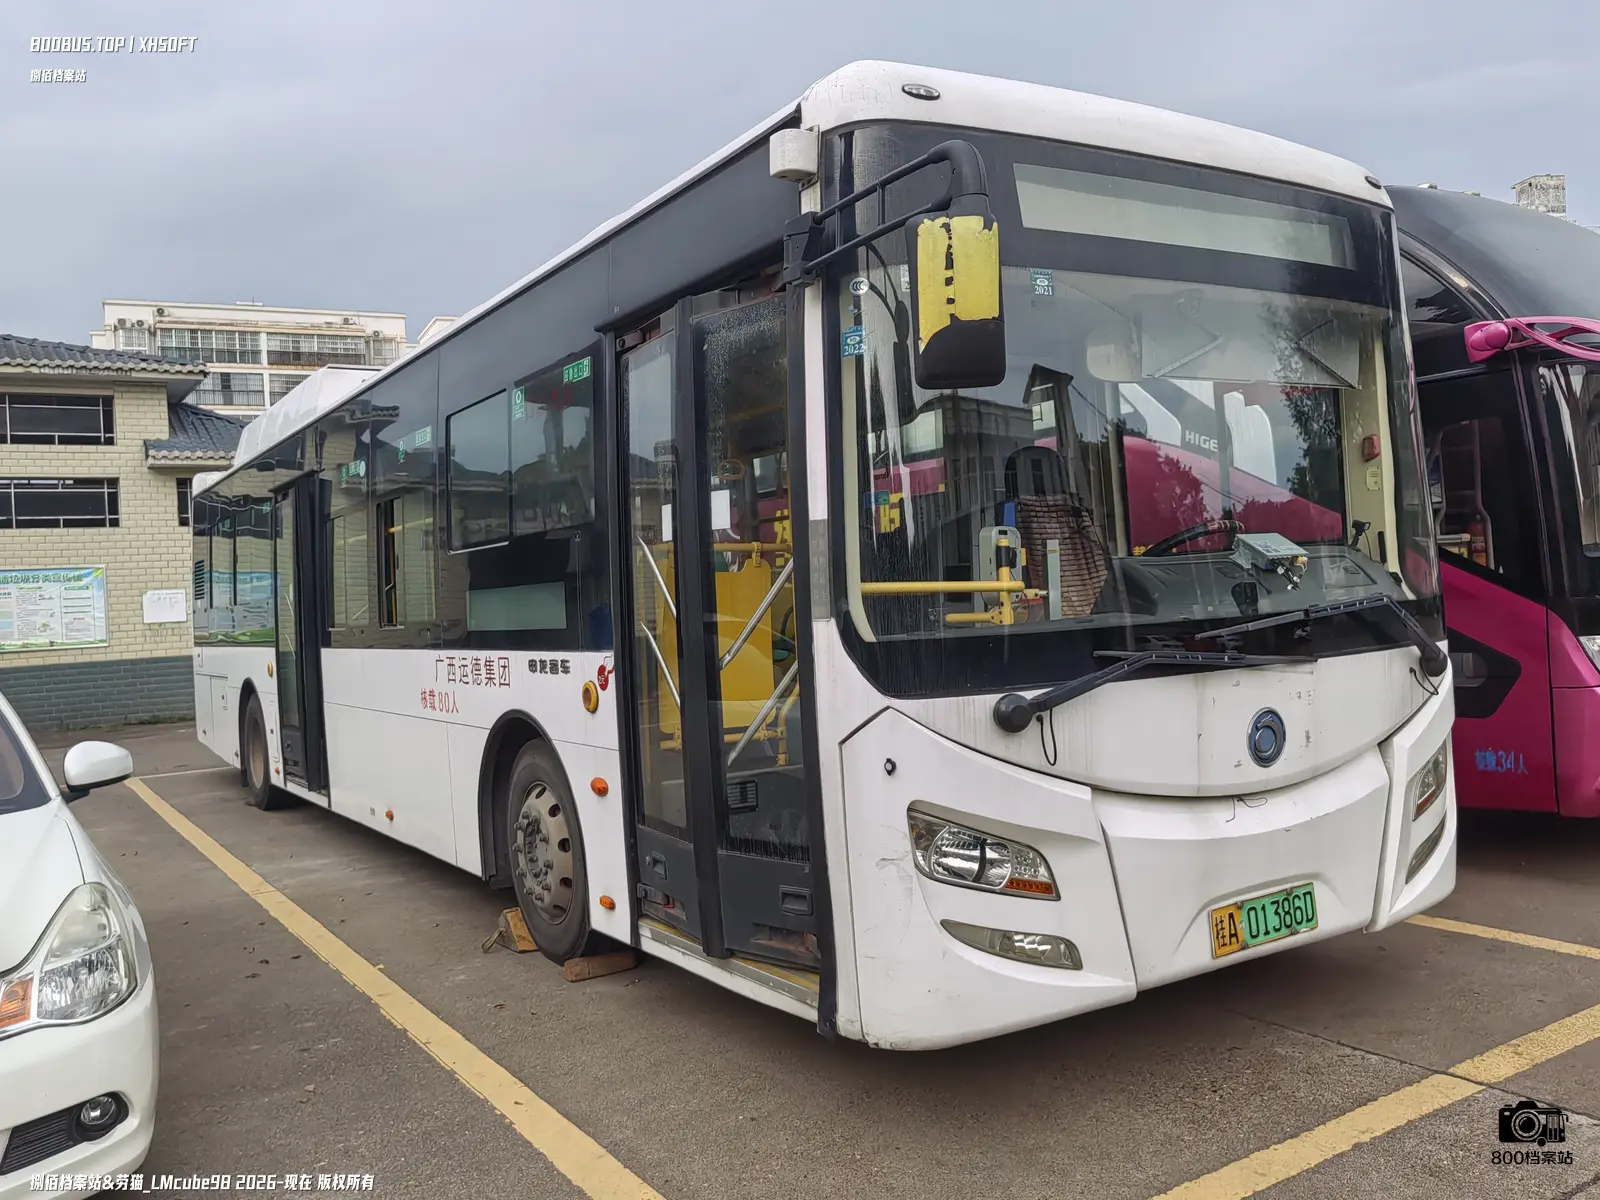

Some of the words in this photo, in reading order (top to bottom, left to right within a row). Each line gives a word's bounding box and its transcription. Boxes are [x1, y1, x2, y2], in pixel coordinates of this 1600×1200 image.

[1035, 285, 1052, 295] 2021
[843, 343, 866, 355] 2022
[1185, 430, 1219, 452] HIGE
[435, 654, 511, 689] 广西运德集团
[528, 658, 571, 675] 申龙客车
